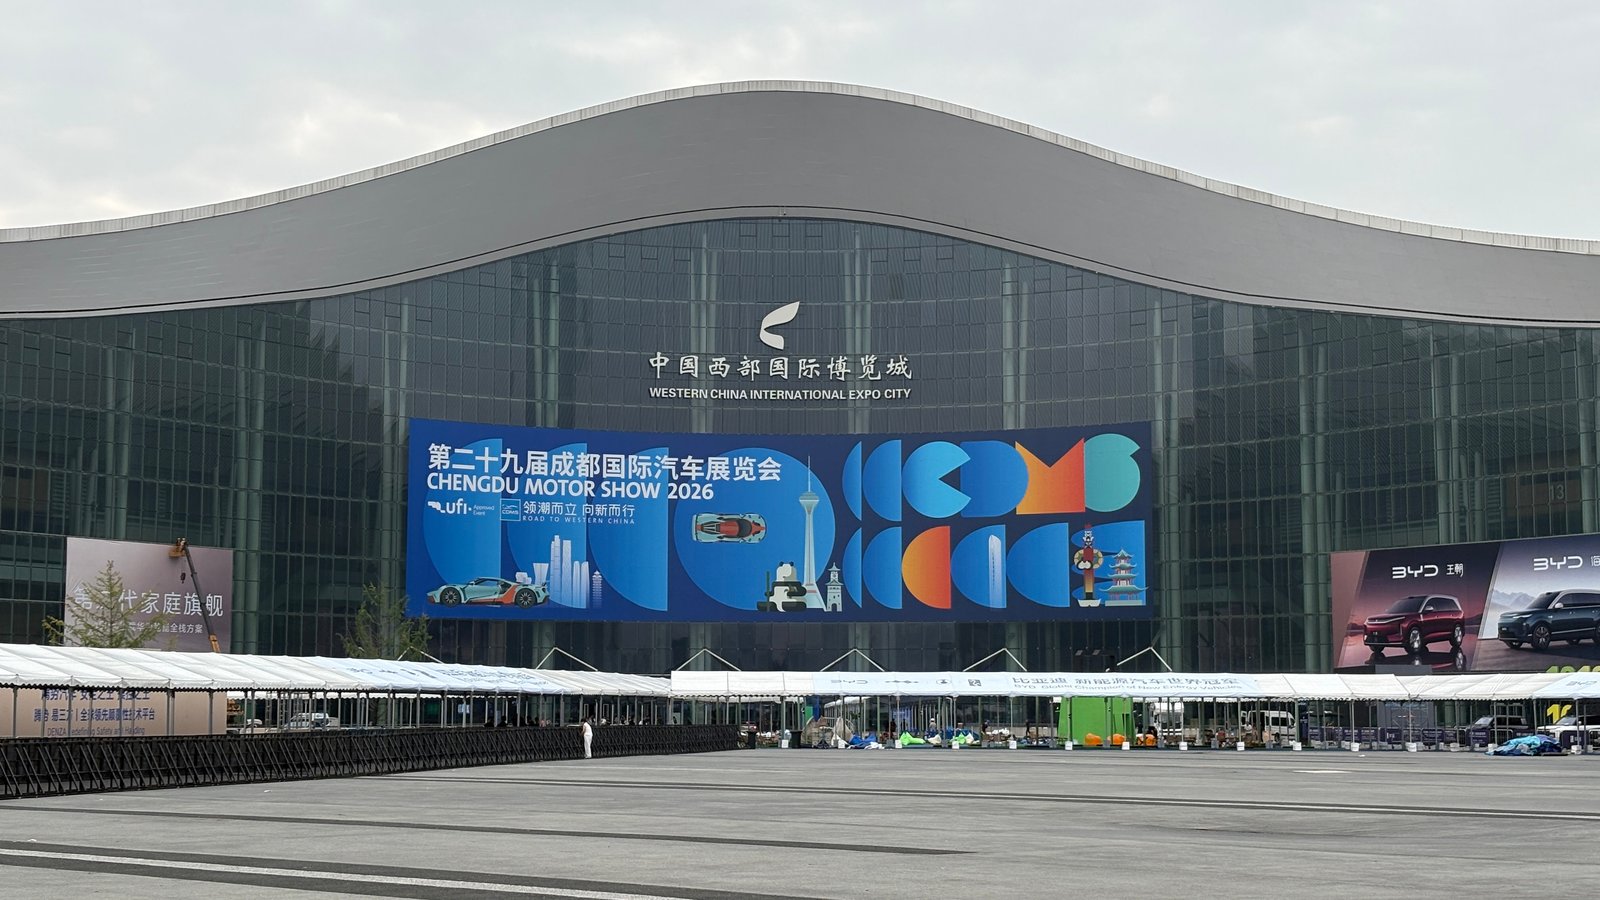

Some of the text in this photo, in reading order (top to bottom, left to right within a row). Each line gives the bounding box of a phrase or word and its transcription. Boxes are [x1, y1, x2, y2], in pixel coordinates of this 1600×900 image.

[648, 351, 912, 381] 中国西部国际博览城
[649, 387, 911, 401] WESTERN CHINA INTERNATIONAL EXPO CITY
[427, 443, 781, 482] 第二十九届成都国际汽车展览会
[427, 472, 714, 500] CHENGDU MOTOR SHOW 2026
[523, 501, 635, 518] 领潮而立 向新而行
[564, 516, 603, 524] WESTERN
[1392, 563, 1463, 579] BYD 王朝
[1533, 556, 1583, 571] BYD
